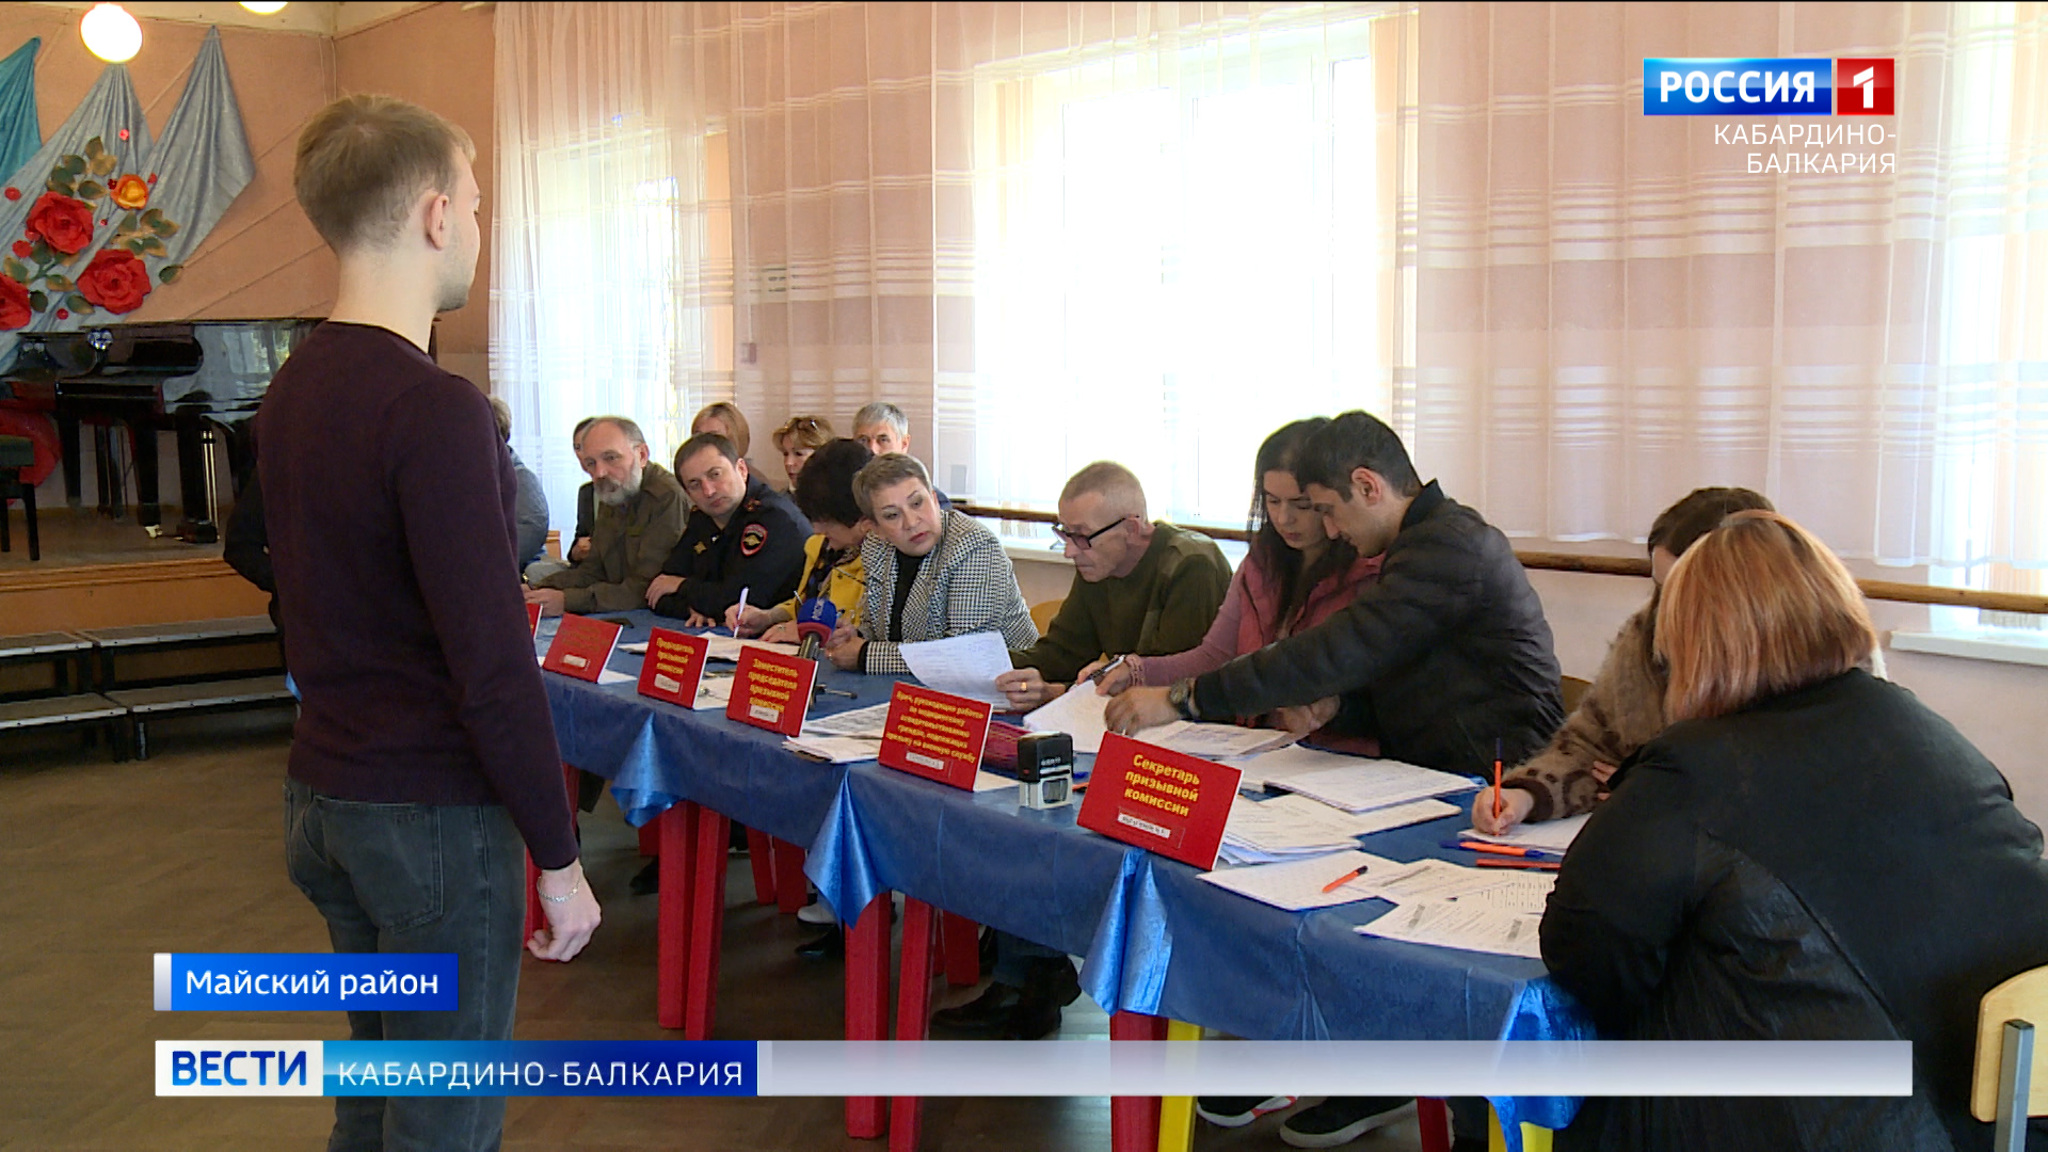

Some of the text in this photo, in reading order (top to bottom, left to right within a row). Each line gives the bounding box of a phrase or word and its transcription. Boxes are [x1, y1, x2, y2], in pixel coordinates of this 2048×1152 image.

[1133, 754, 1200, 785] Секретарь
[1125, 771, 1199, 802] призывной
[1124, 788, 1189, 817] комиссии
